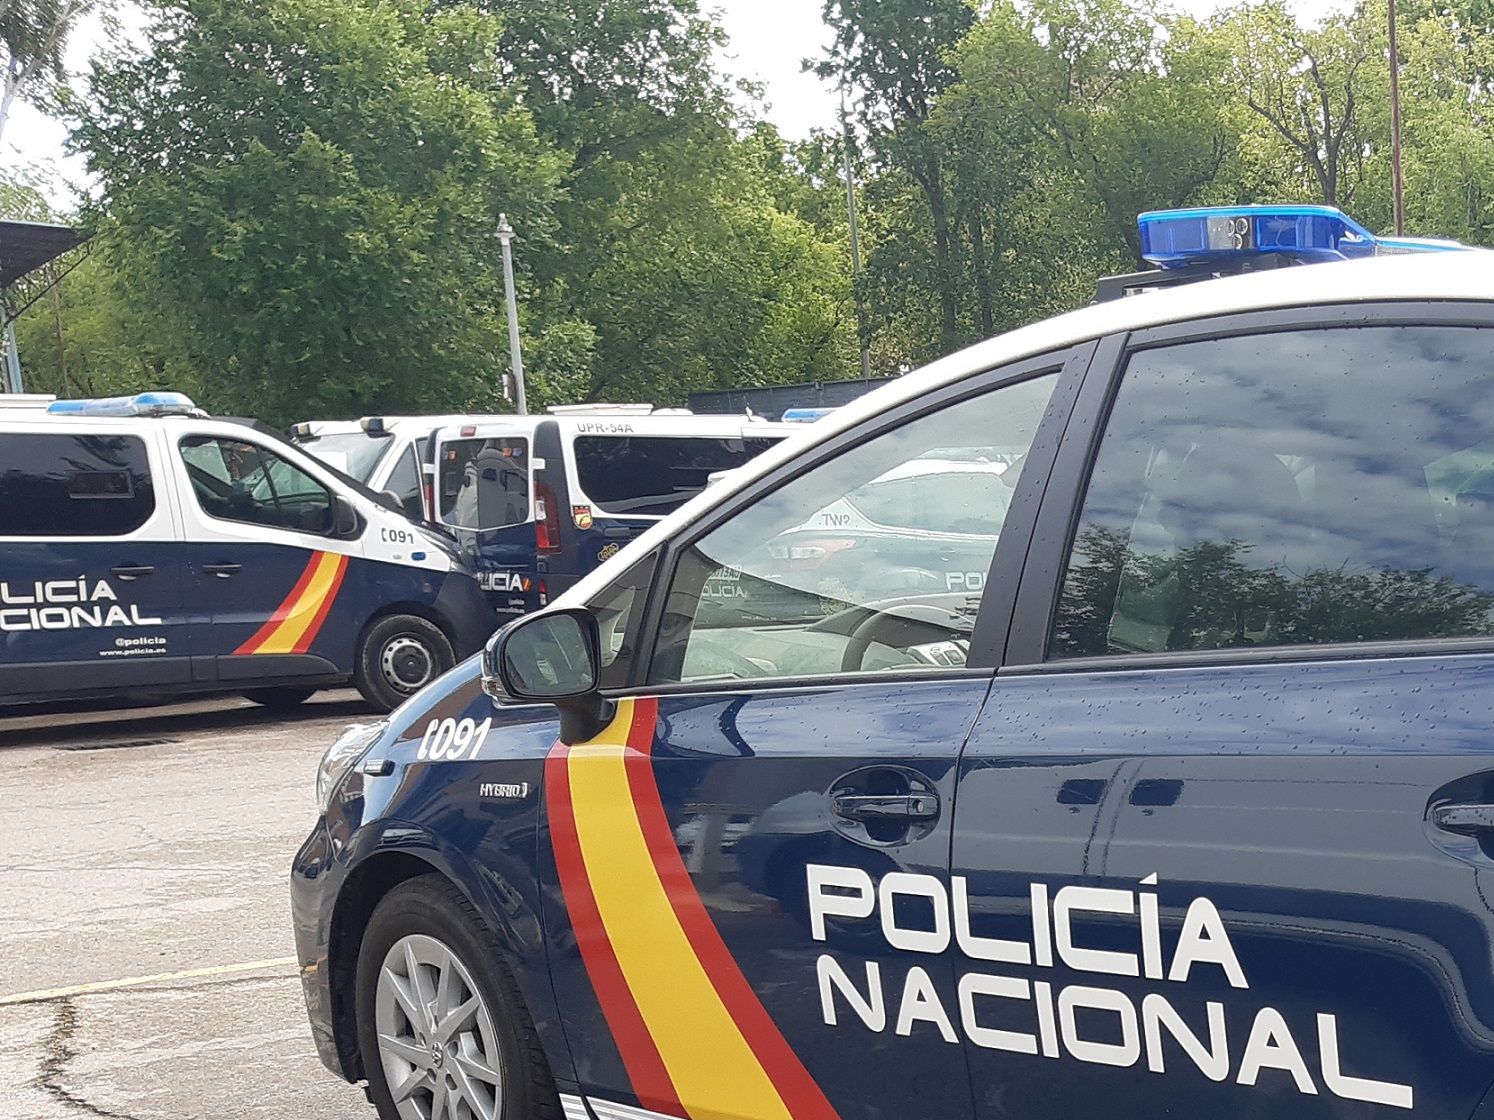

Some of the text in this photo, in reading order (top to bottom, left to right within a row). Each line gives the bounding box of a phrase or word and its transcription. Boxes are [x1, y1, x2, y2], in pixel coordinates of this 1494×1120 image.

[577, 423, 634, 433] UPR-54A
[389, 529, 414, 544] 091
[0, 604, 163, 631] CIONAL
[115, 637, 167, 646] @policia
[429, 716, 492, 760] 091
[806, 863, 1249, 989] POLICÍA
[816, 954, 1414, 1109] NACIONAL
